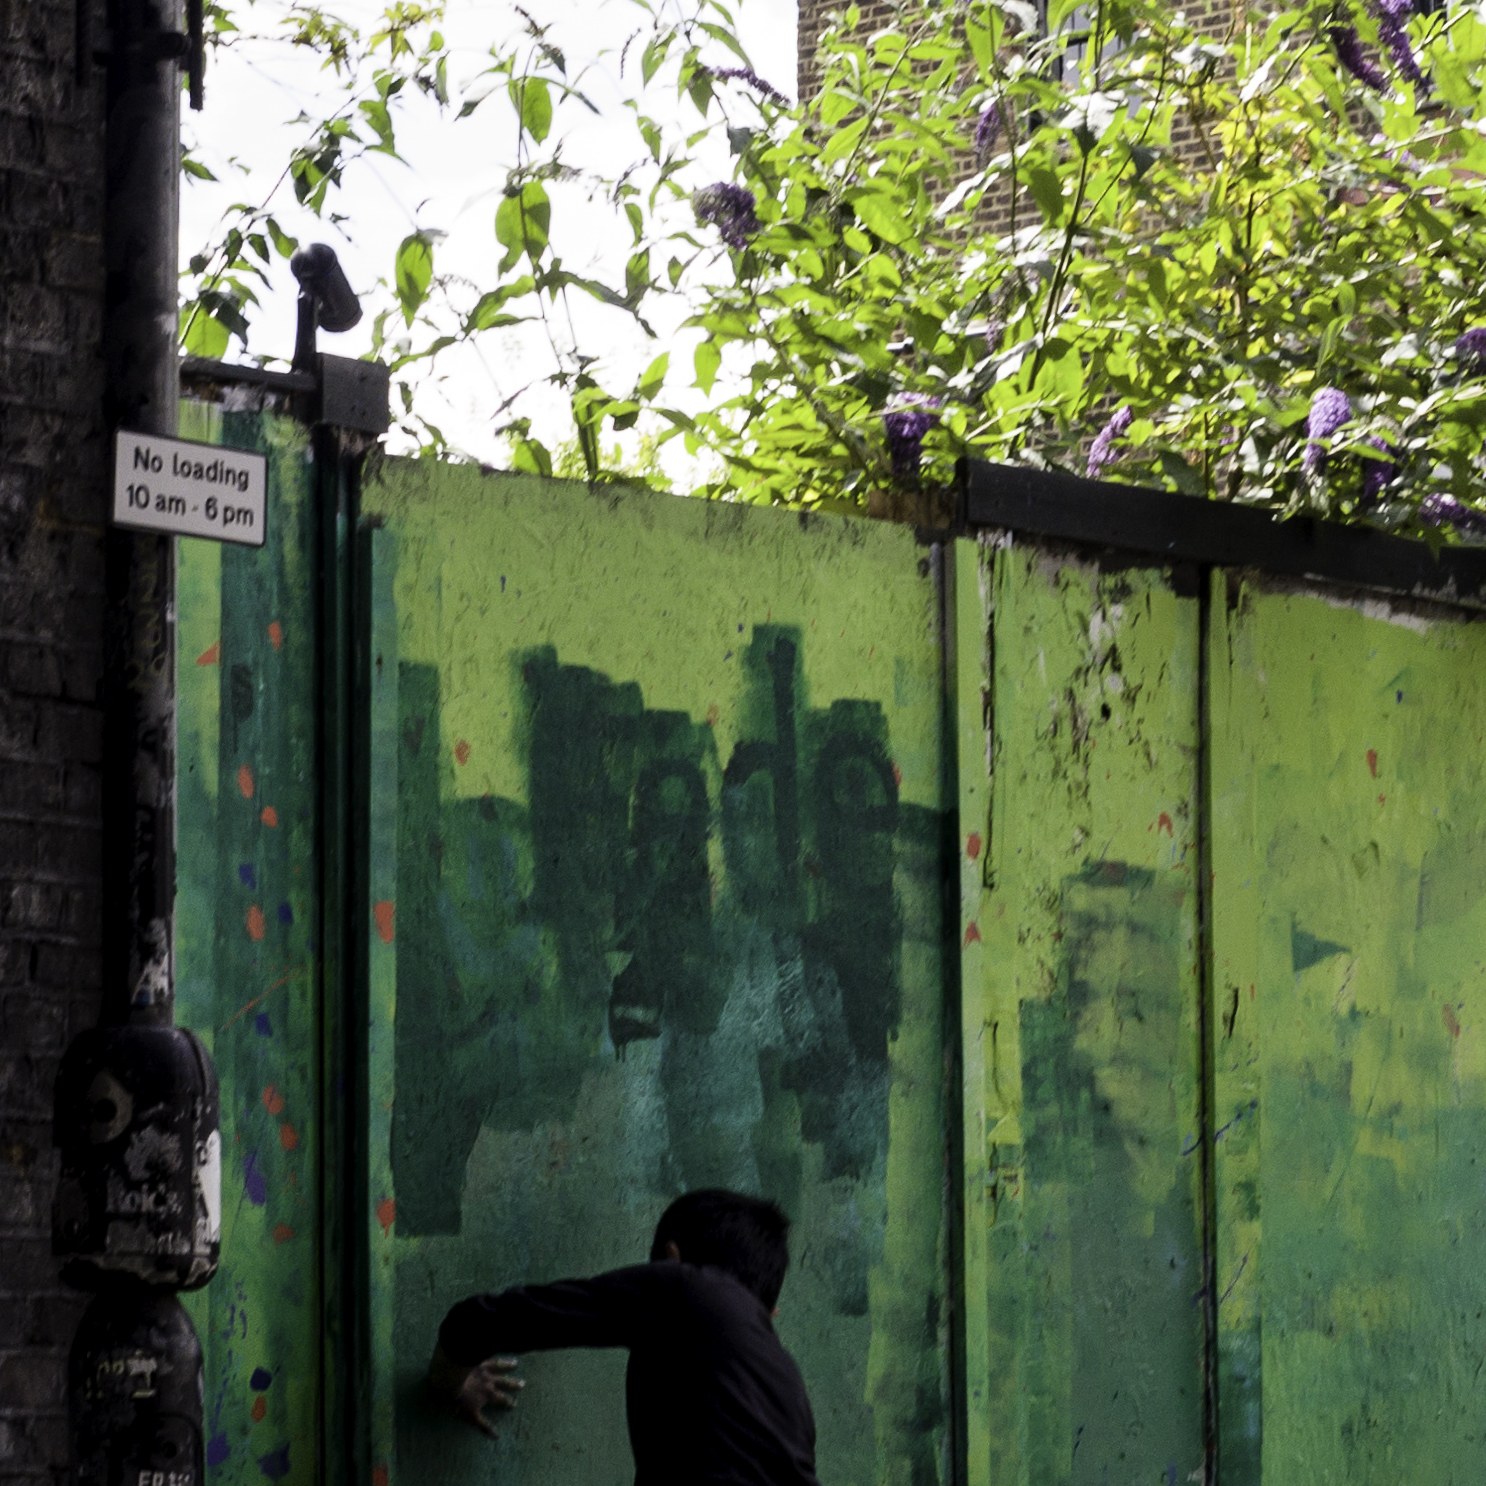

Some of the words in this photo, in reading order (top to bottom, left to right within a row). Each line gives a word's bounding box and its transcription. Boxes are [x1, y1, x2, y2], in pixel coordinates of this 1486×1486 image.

[132, 445, 163, 474] No
[173, 452, 250, 492] loading
[125, 483, 151, 510] 10
[154, 491, 187, 517] am
[204, 495, 219, 521] 6
[222, 503, 255, 528] pm
